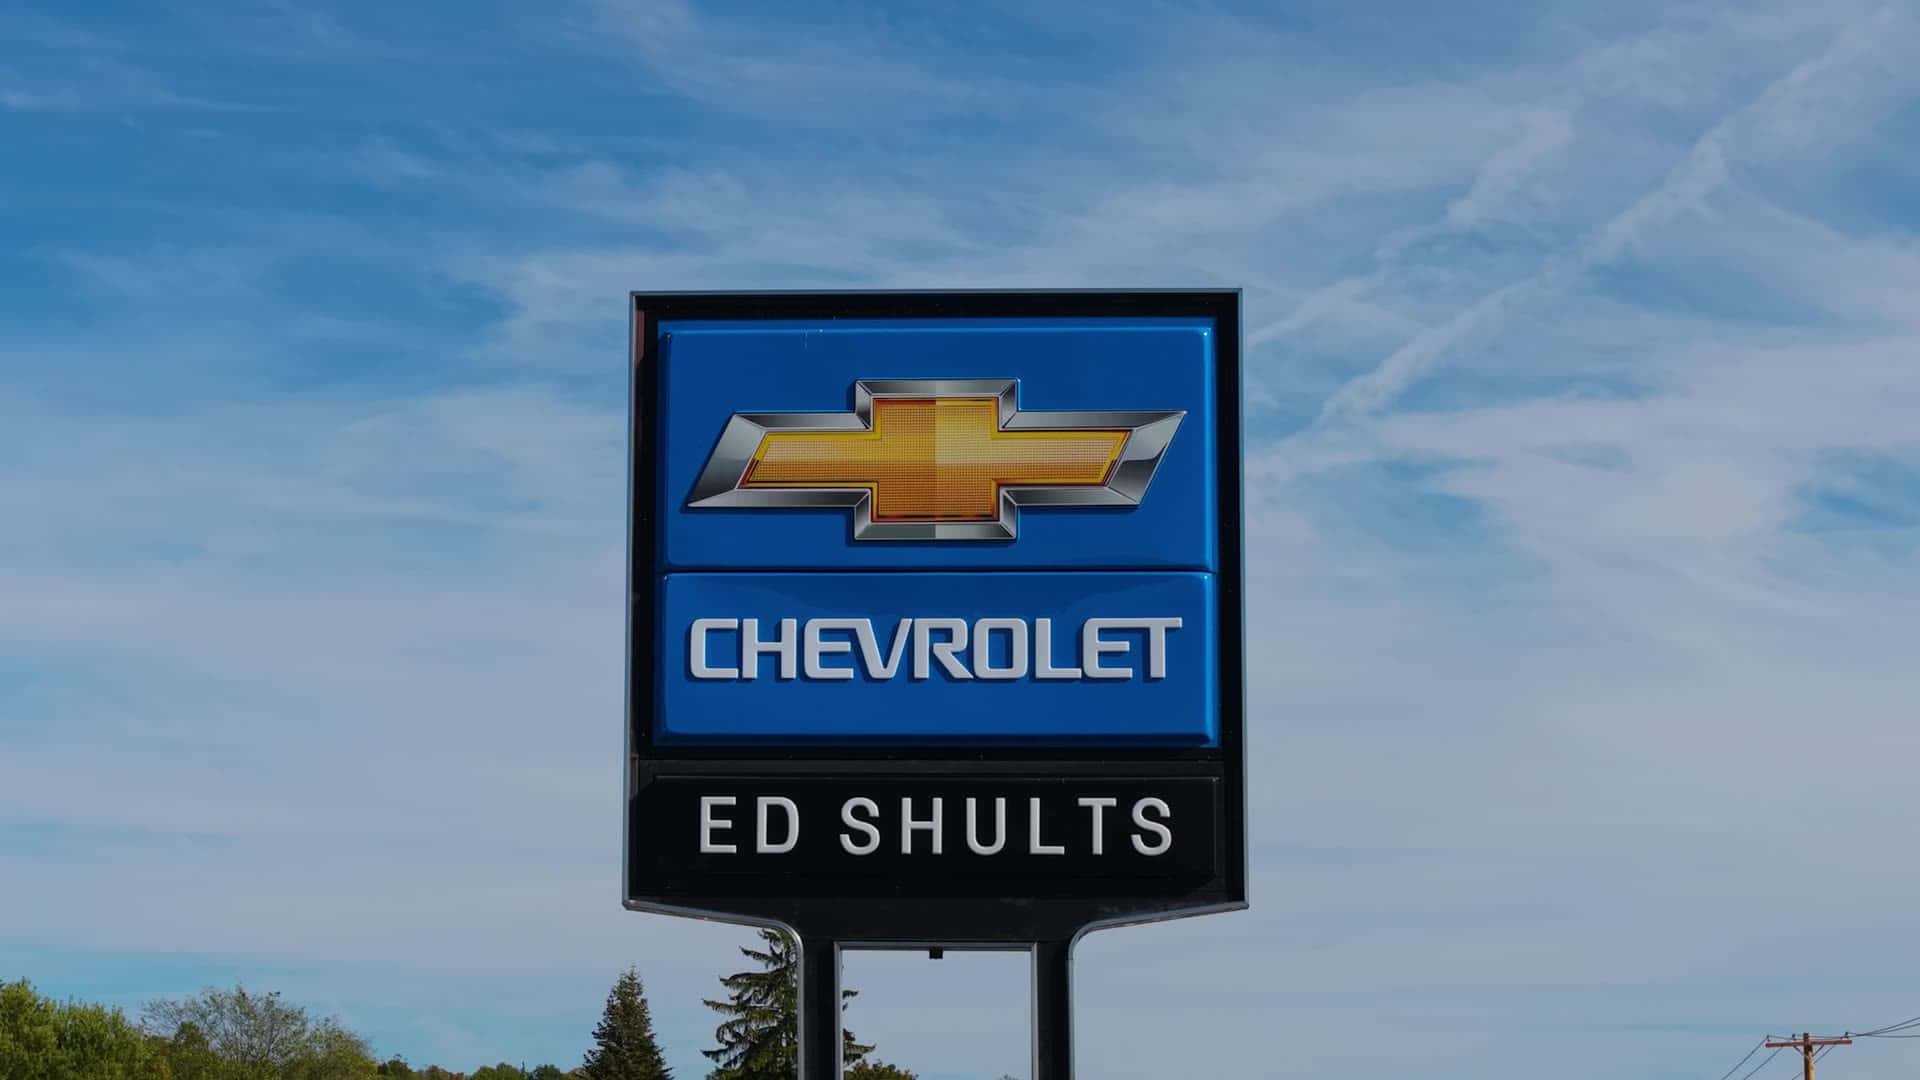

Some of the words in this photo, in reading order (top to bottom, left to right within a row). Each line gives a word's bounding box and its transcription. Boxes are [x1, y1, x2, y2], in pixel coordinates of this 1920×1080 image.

[689, 617, 1183, 680] CHEVROLET
[699, 796, 800, 854] ED
[839, 796, 1173, 856] SHULTS
